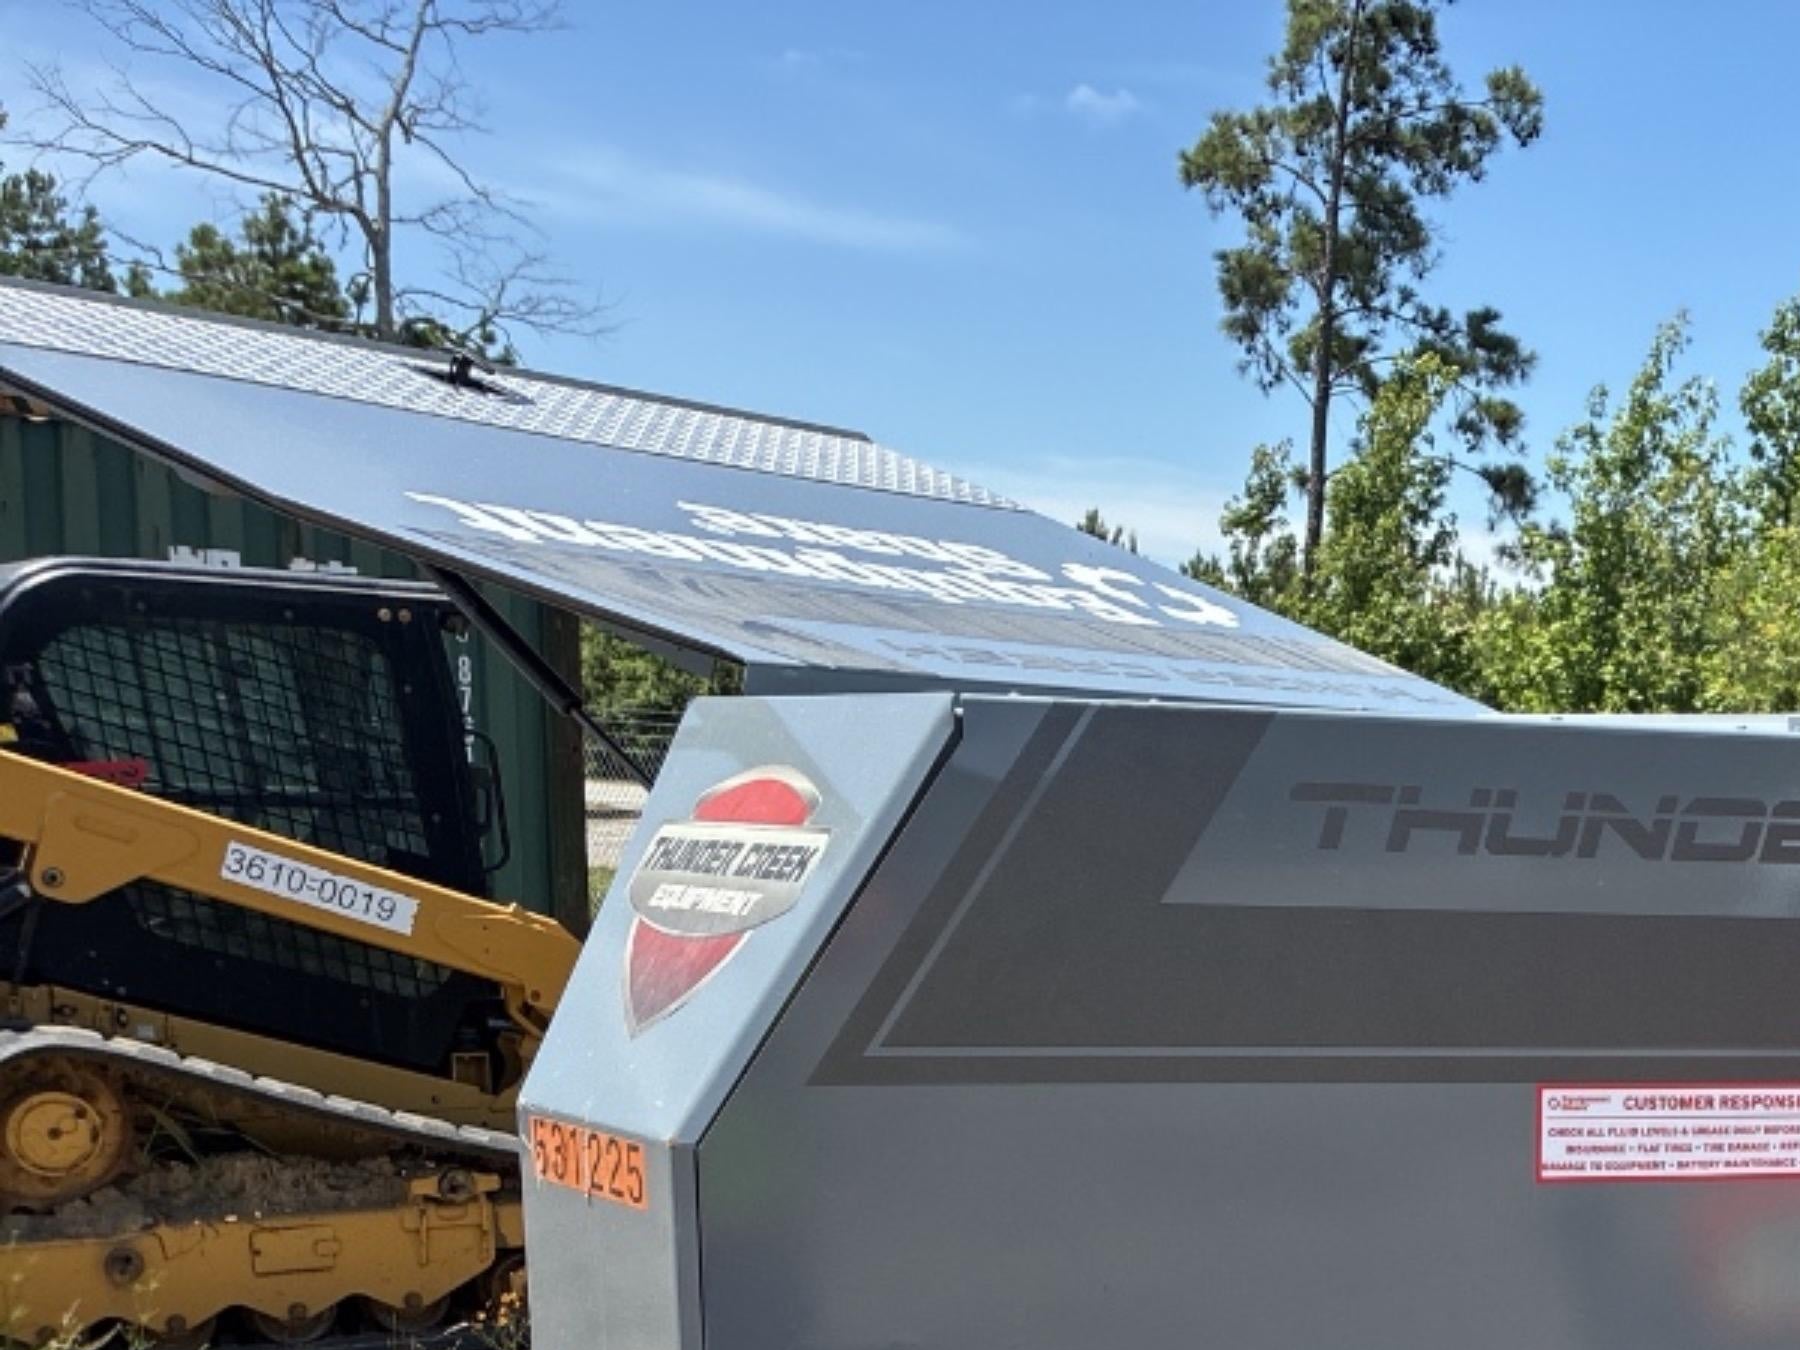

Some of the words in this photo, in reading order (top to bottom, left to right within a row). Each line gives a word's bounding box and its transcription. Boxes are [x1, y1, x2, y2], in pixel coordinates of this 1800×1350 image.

[644, 836, 746, 877] THUNDER
[732, 842, 820, 883] CREEK
[226, 848, 397, 922] 3610-0019
[648, 883, 765, 917] EQUIPMENT
[1622, 1095, 1714, 1111] CUSTOMER
[532, 1118, 644, 1204] 531225
